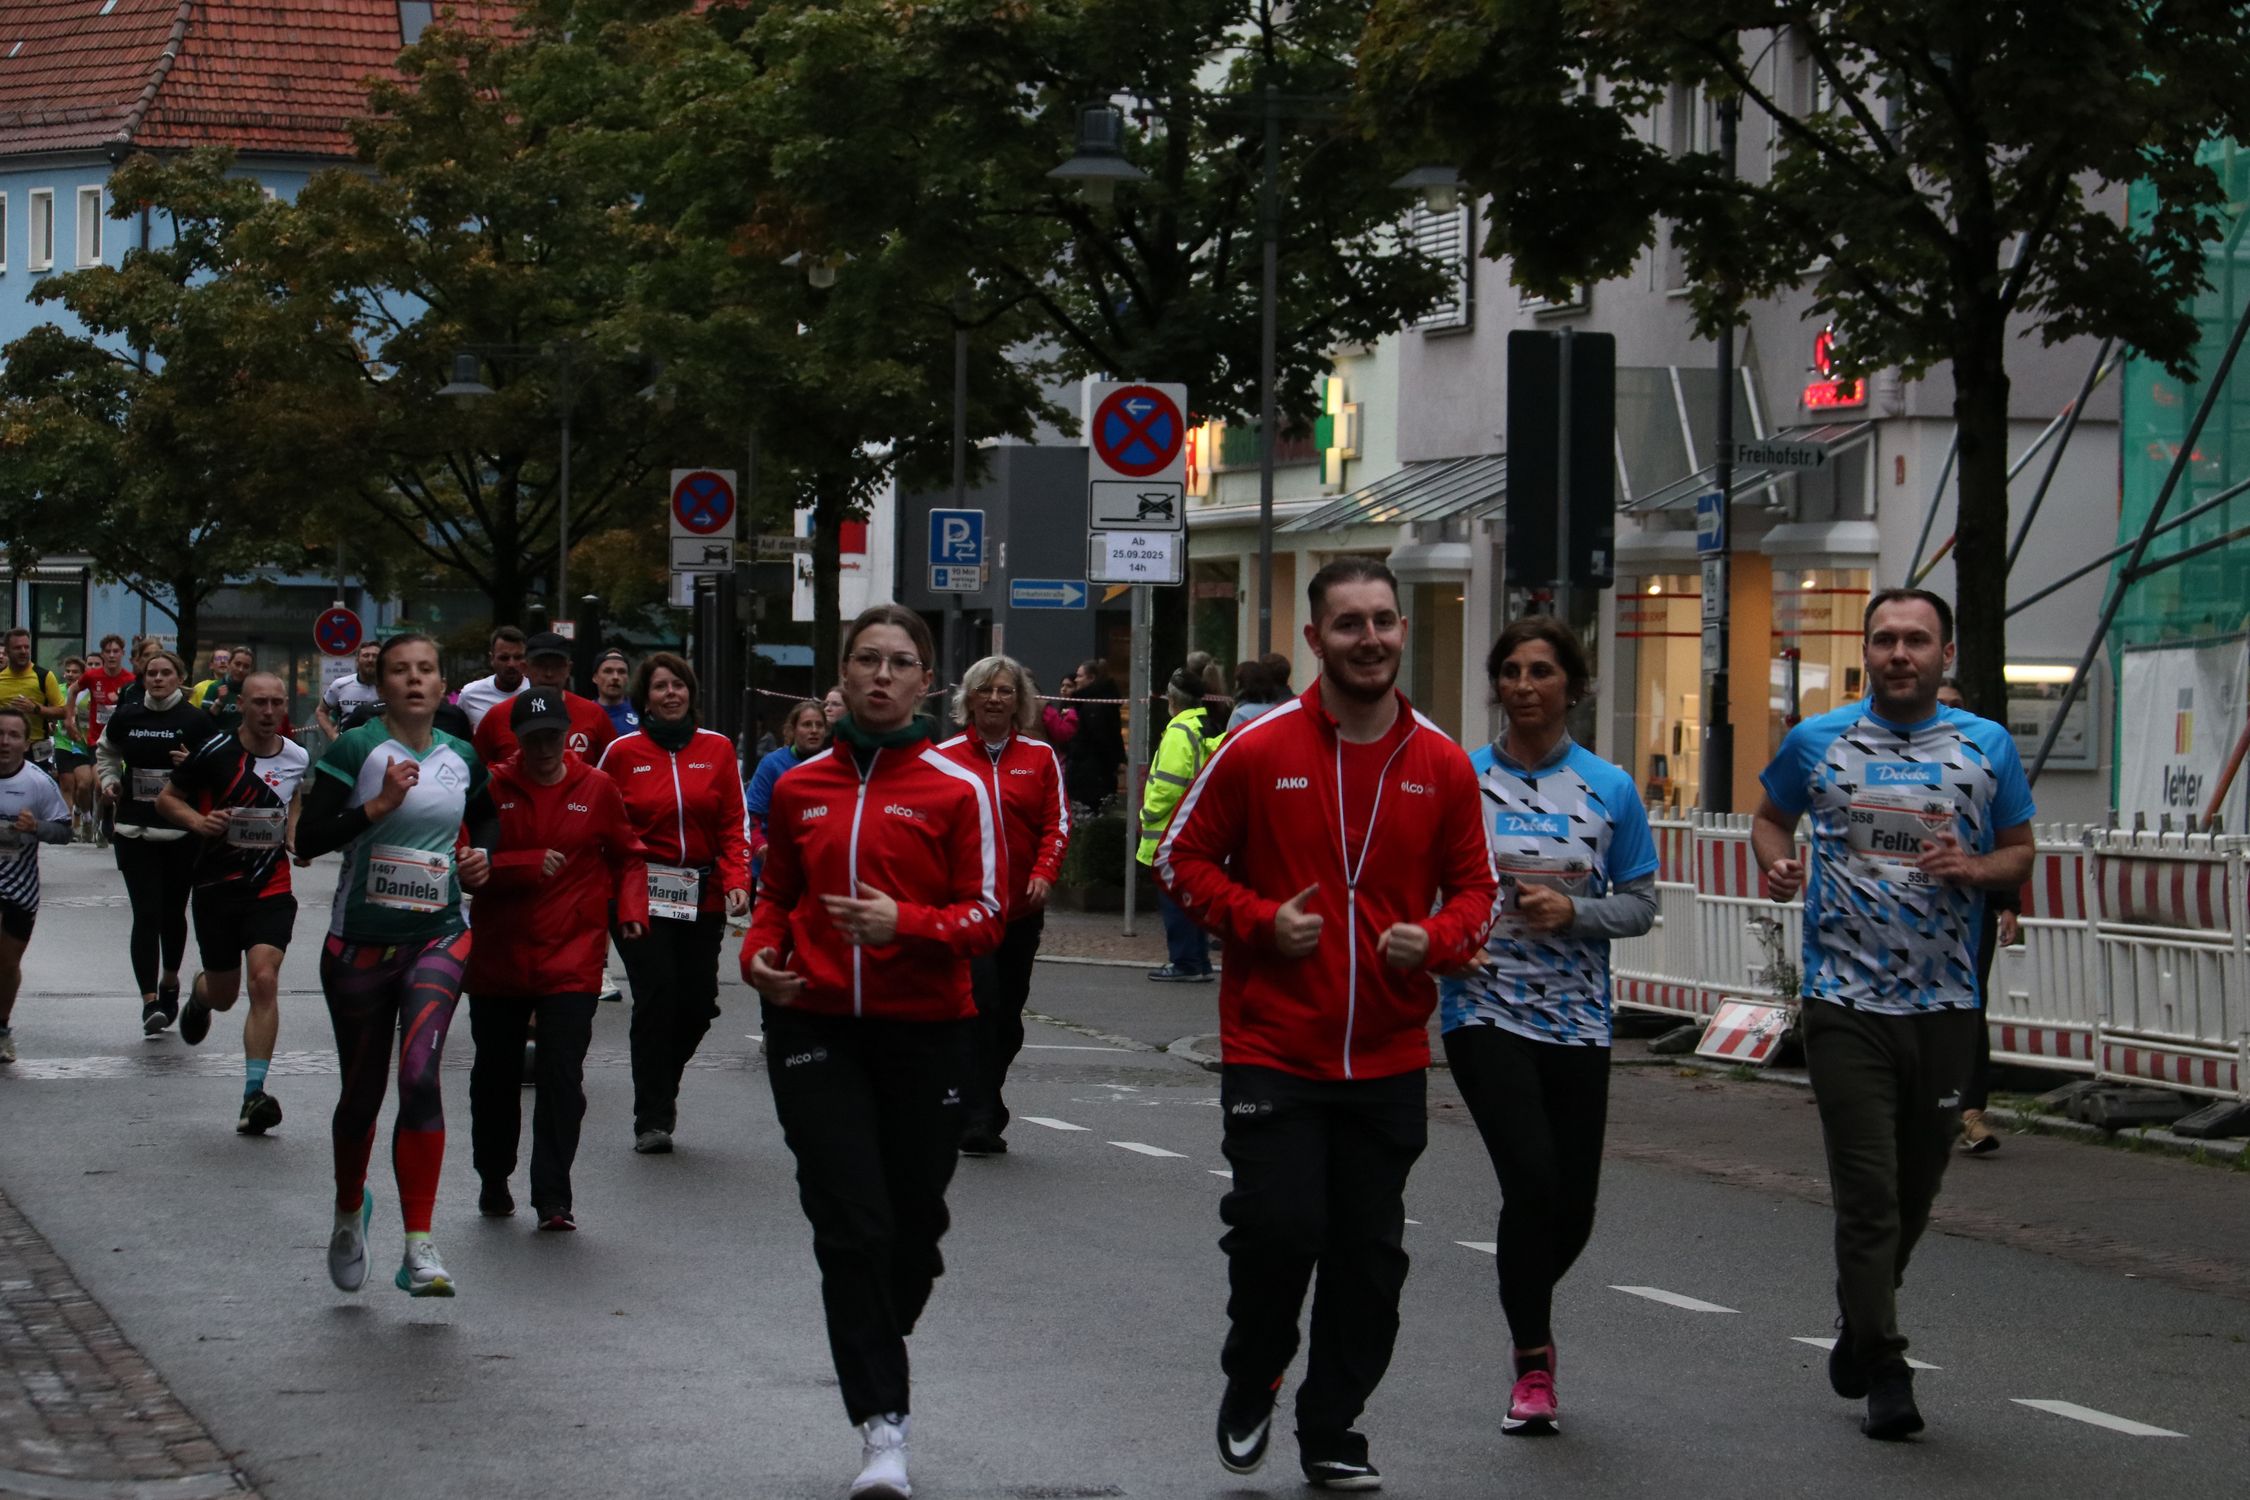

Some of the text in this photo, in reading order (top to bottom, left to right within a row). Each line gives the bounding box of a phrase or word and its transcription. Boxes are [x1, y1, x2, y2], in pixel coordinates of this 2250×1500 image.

[1738, 445, 1814, 465] Freihofstr.
[1132, 538, 1145, 546] Ab
[1113, 550, 1164, 559] 25.09.2025
[128, 728, 175, 739] Alphartis
[633, 765, 652, 775] JAKO
[1876, 765, 1930, 781] Debeka
[1275, 777, 1308, 791] JAKO
[1401, 780, 1424, 795] elco
[567, 803, 588, 812] elco
[802, 805, 828, 820] JAKO
[884, 803, 913, 818] elco
[1504, 815, 1559, 833] Debeka
[1851, 811, 1874, 824] 558
[240, 829, 272, 841] Kevin
[1871, 829, 1920, 853] Felix
[372, 863, 397, 875] 1467
[1908, 871, 1930, 884] 558
[375, 877, 440, 900] Daniela
[648, 885, 688, 903] Margit
[673, 911, 690, 920] 1768
[785, 1052, 812, 1067] elco
[1231, 1102, 1256, 1115] elco
